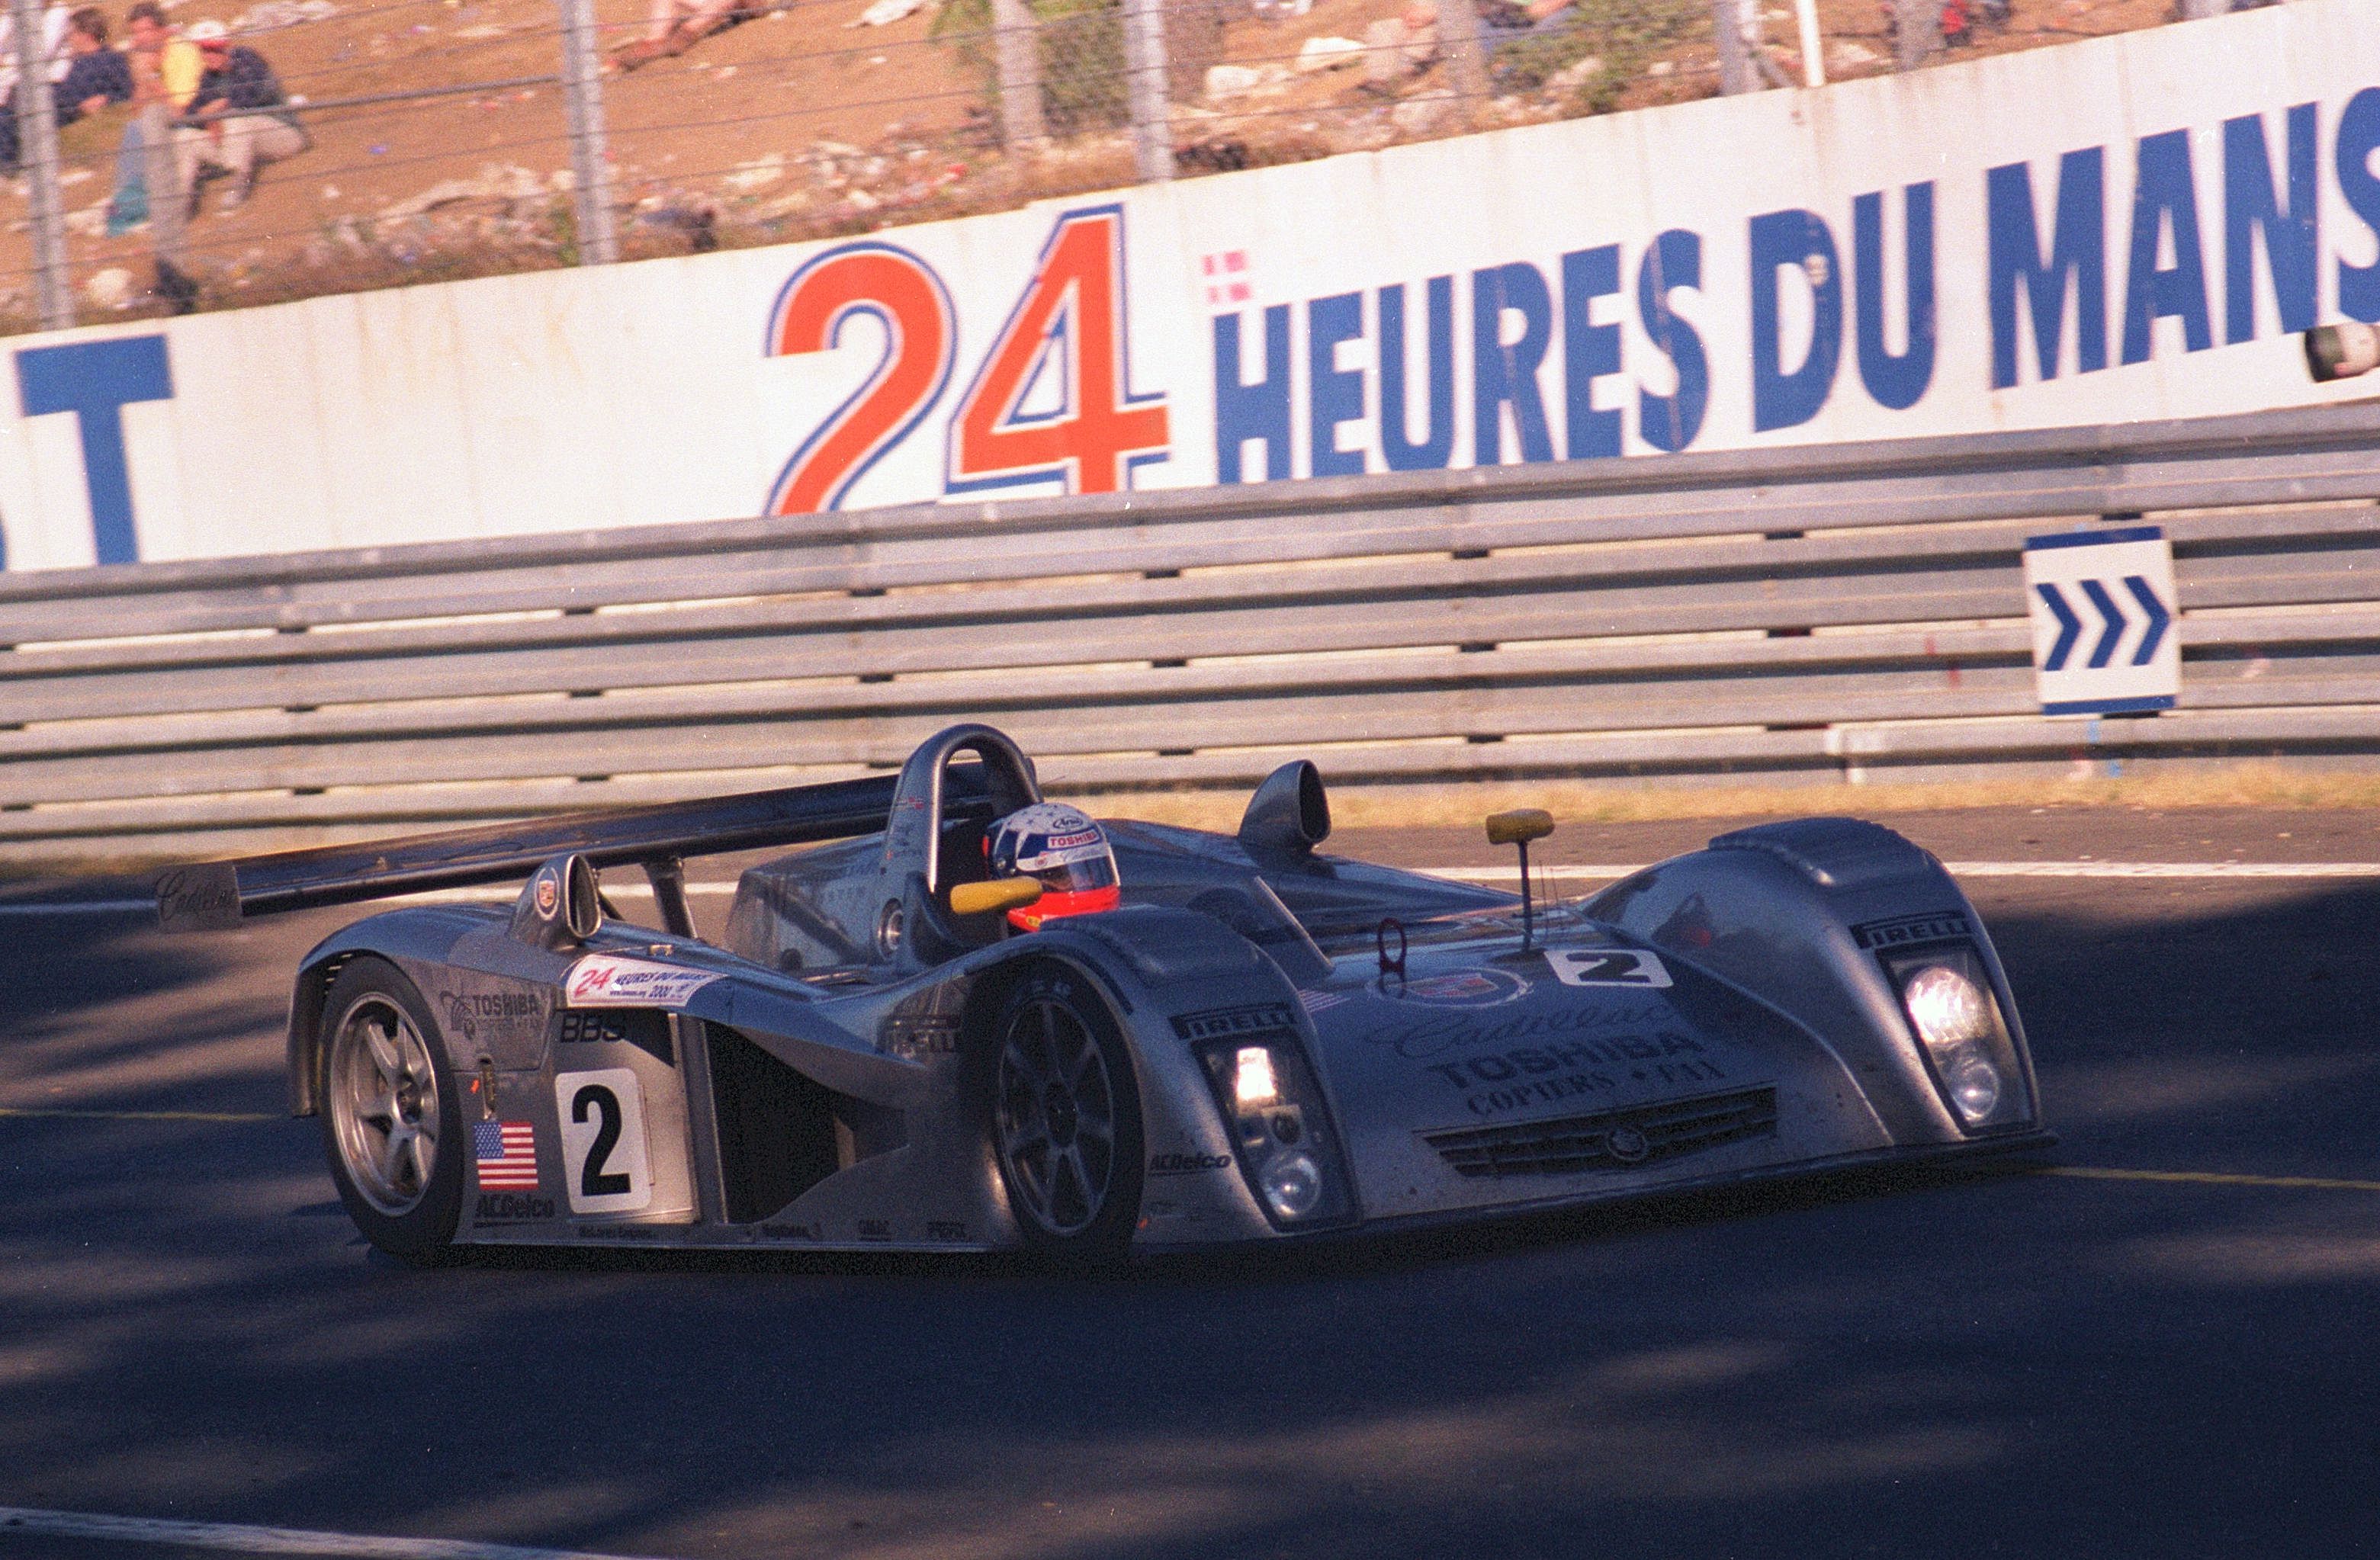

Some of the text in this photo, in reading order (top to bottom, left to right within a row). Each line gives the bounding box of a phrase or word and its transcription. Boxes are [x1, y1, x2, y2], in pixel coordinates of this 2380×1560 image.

[763, 203, 1171, 517] 24
[1212, 229, 1710, 485] HEURES
[1749, 179, 1938, 432] DU
[0, 333, 175, 572] T
[1848, 910, 1974, 949] PIRELLI
[574, 966, 617, 998] 24
[615, 972, 655, 984] HEURES
[1566, 952, 1652, 982] 2
[472, 993, 540, 1016] TOSHIBA
[1168, 1002, 1297, 1040] PIRELLI
[560, 1013, 627, 1042] BBS
[1425, 1031, 1707, 1090] TOSHIBA
[1467, 1070, 1616, 1116] COPIERS
[572, 1084, 631, 1196] 2
[1149, 1151, 1231, 1171] ACDelco
[475, 1193, 556, 1219] ACDelco
